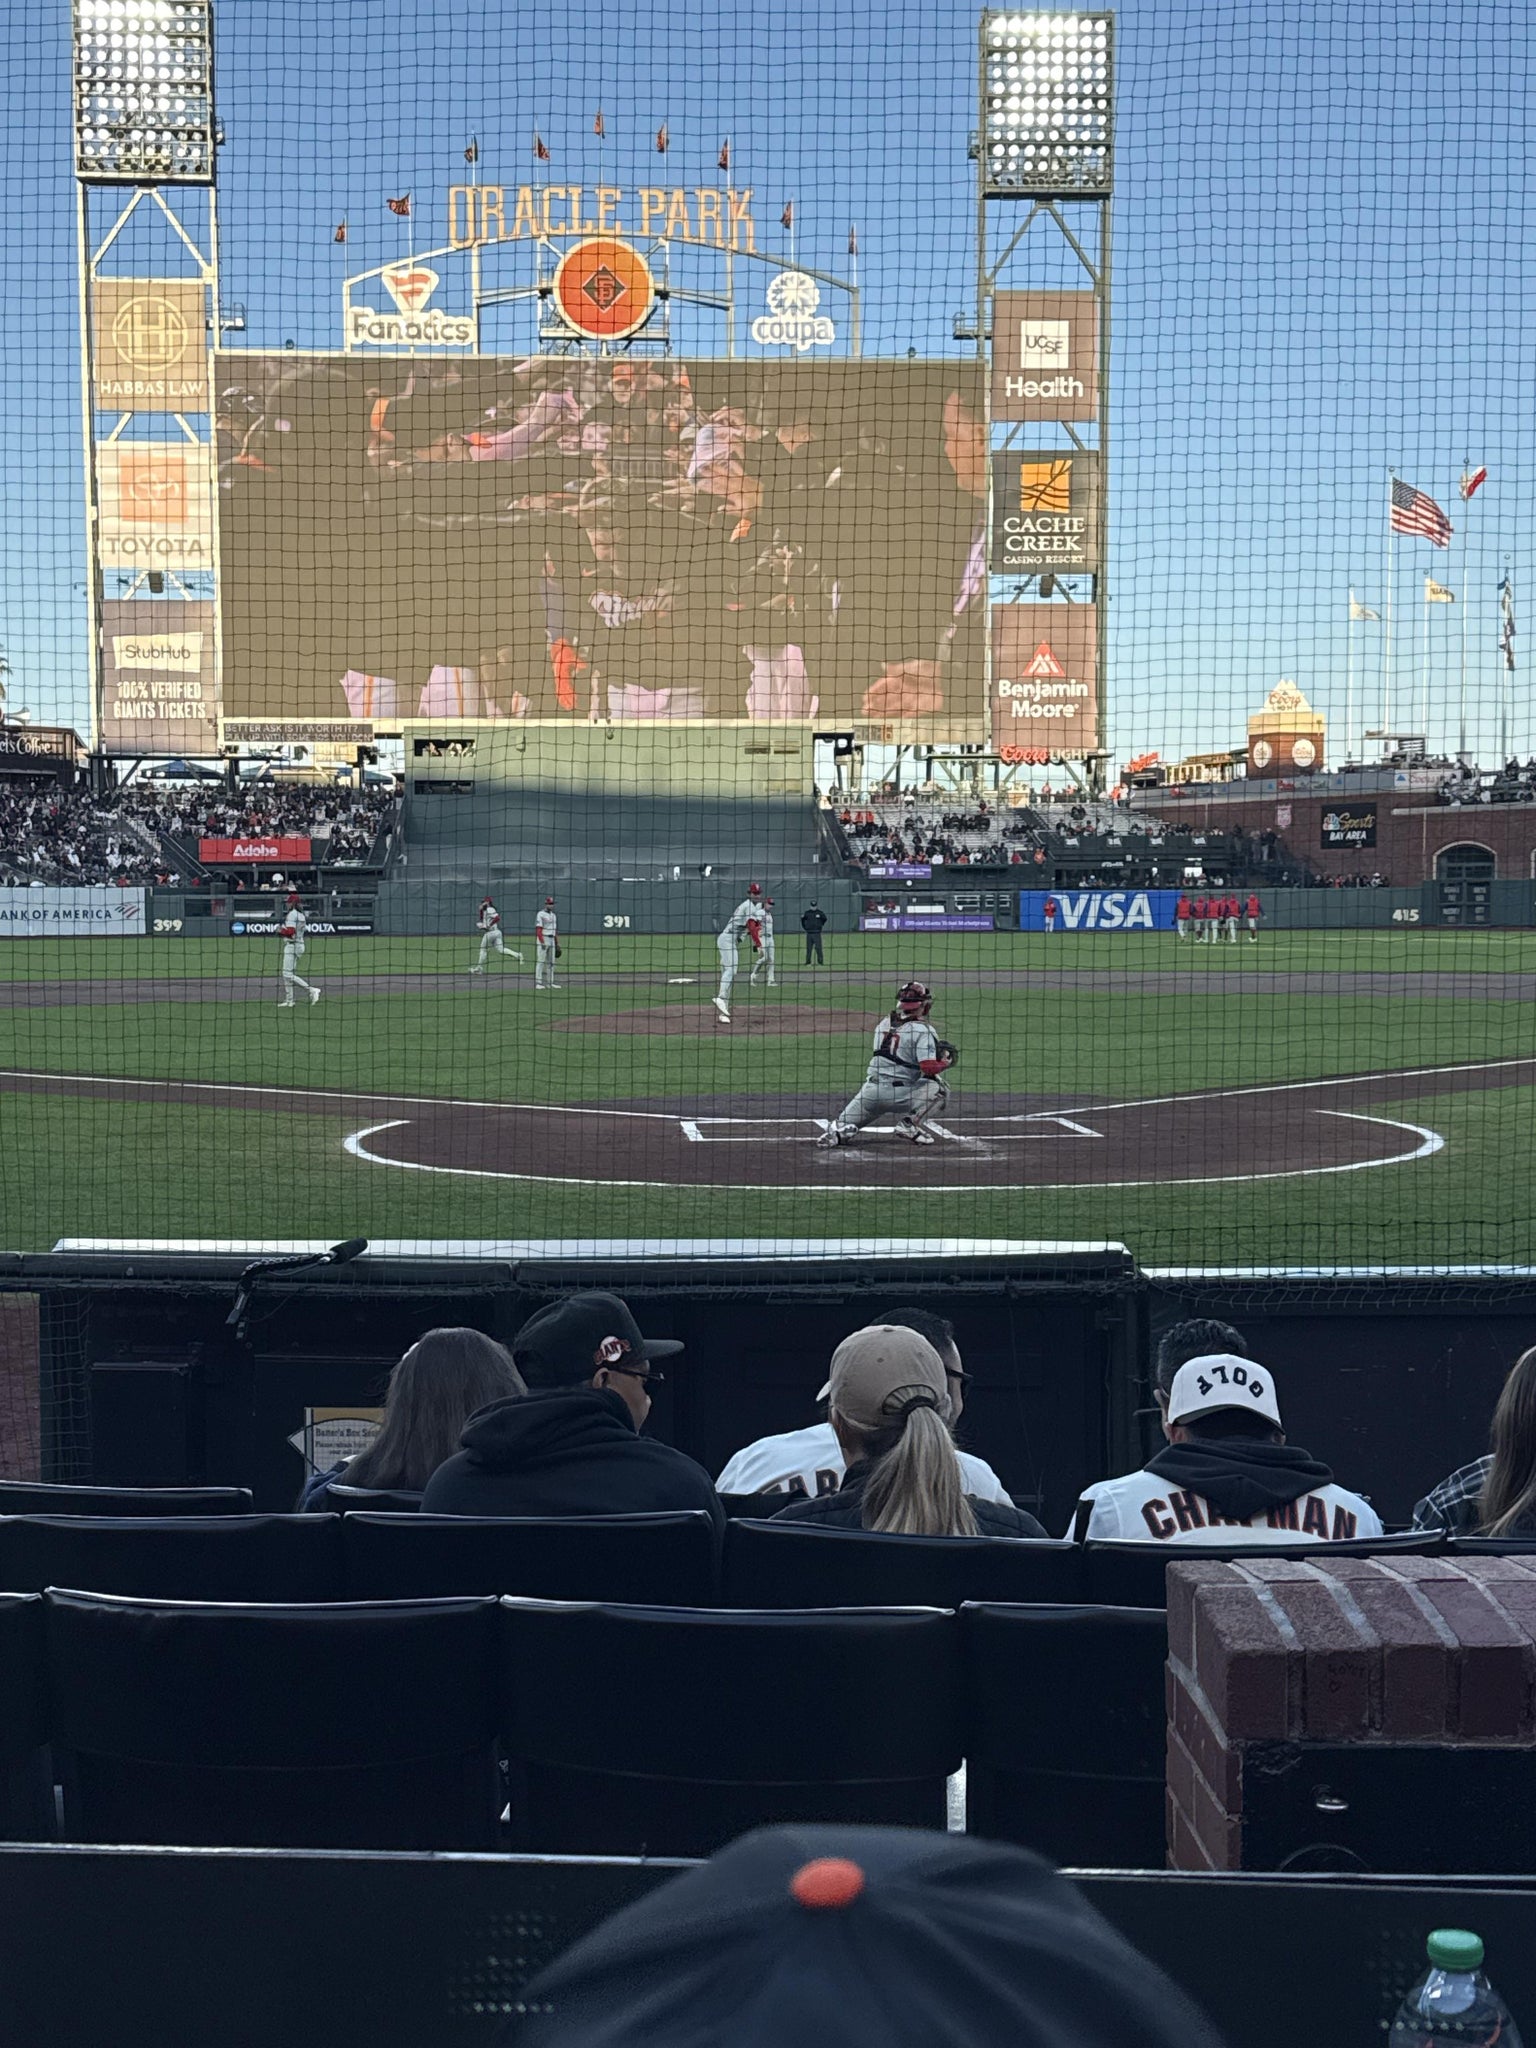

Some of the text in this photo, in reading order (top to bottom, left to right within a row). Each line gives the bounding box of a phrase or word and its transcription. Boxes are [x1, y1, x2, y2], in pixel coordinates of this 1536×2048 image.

[449, 185, 756, 254] ORACLE PARK
[353, 312, 470, 342] Fanatics
[757, 320, 832, 346] coupa
[1026, 335, 1064, 355] UCSF
[100, 380, 203, 395] HABBAS LAW
[1005, 376, 1084, 397] Health
[1003, 517, 1085, 533] CACHE
[106, 538, 206, 556] TOYOTA
[1006, 535, 1082, 551] CREEK
[1003, 555, 1043, 564] CASINO
[125, 644, 191, 660] StubHub
[117, 682, 202, 699] 100% VERIFIED
[998, 679, 1088, 702] Benjamin
[113, 702, 207, 719] GIANTS TICKETS
[1001, 745, 1088, 763] Coors LIGHT
[1339, 812, 1376, 832] Sports
[1329, 830, 1367, 841] BAY AREA
[233, 844, 279, 857] Adobe
[32, 909, 49, 920] OF
[52, 909, 112, 920] AMERICA
[1049, 893, 1154, 928] VISA
[1392, 909, 1419, 922] 415
[153, 919, 183, 932] 399
[246, 923, 283, 934] KONIC
[604, 915, 630, 928] 391
